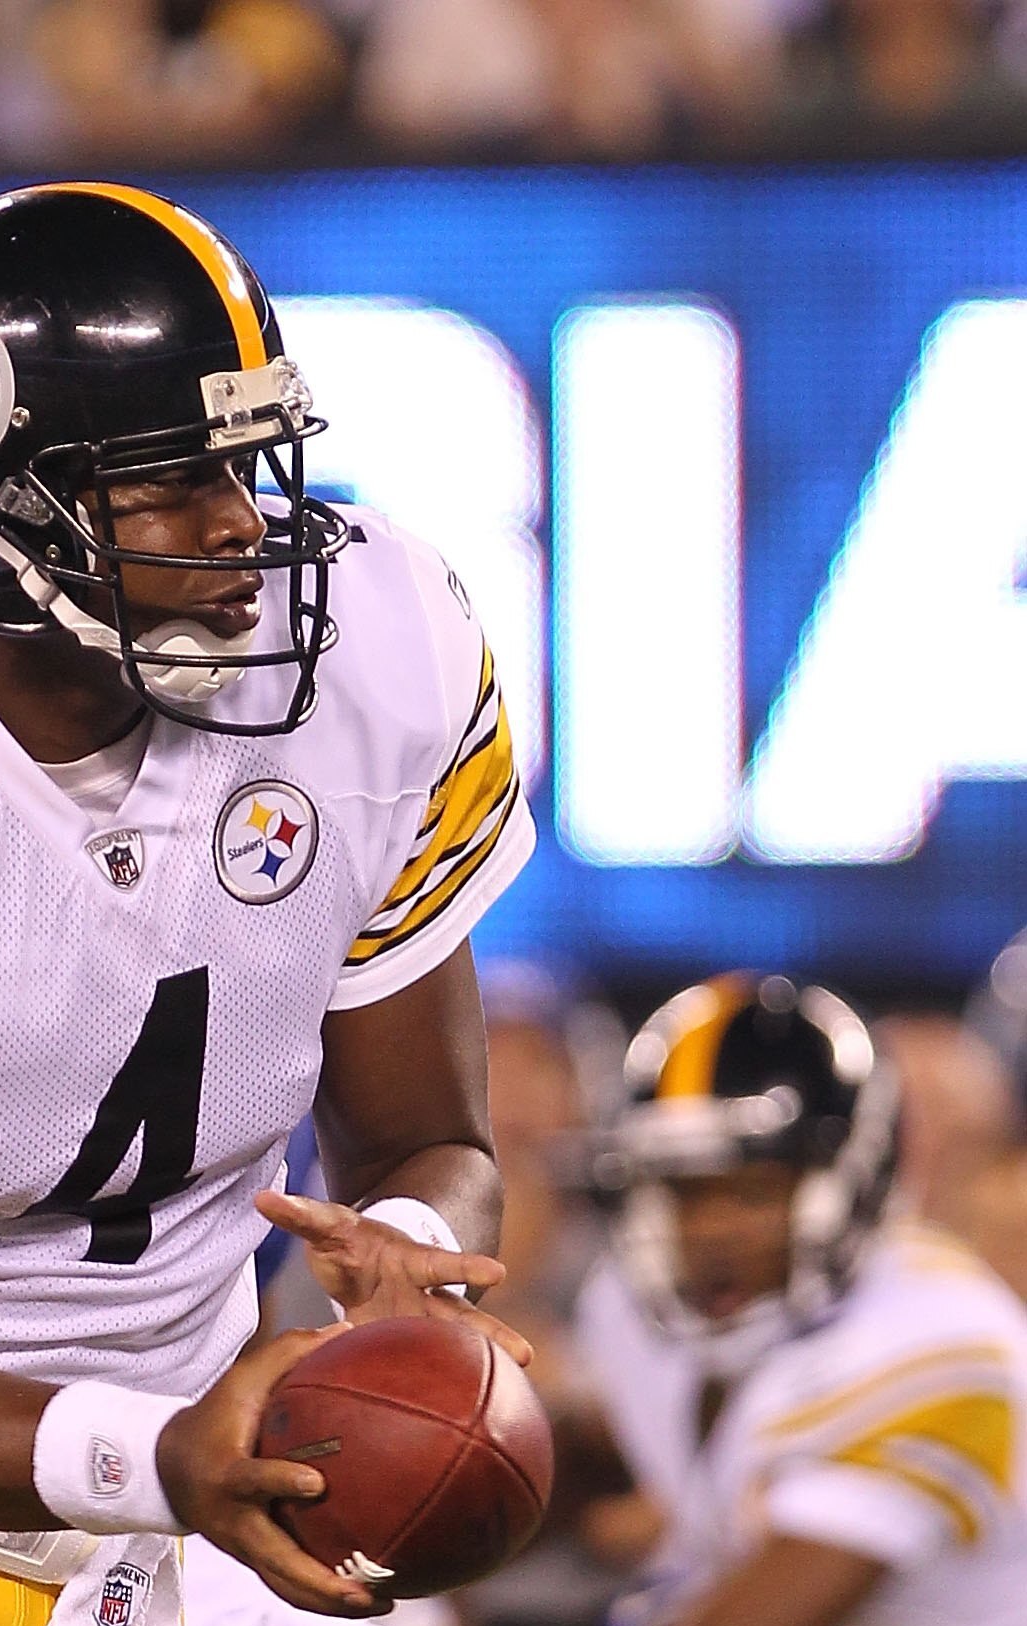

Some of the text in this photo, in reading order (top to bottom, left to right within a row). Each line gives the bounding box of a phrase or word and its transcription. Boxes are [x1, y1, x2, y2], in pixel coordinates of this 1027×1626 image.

[227, 837, 264, 861] Steelers
[111, 858, 138, 882] NFL
[19, 964, 210, 1265] 4
[101, 1600, 128, 1625] NFL
